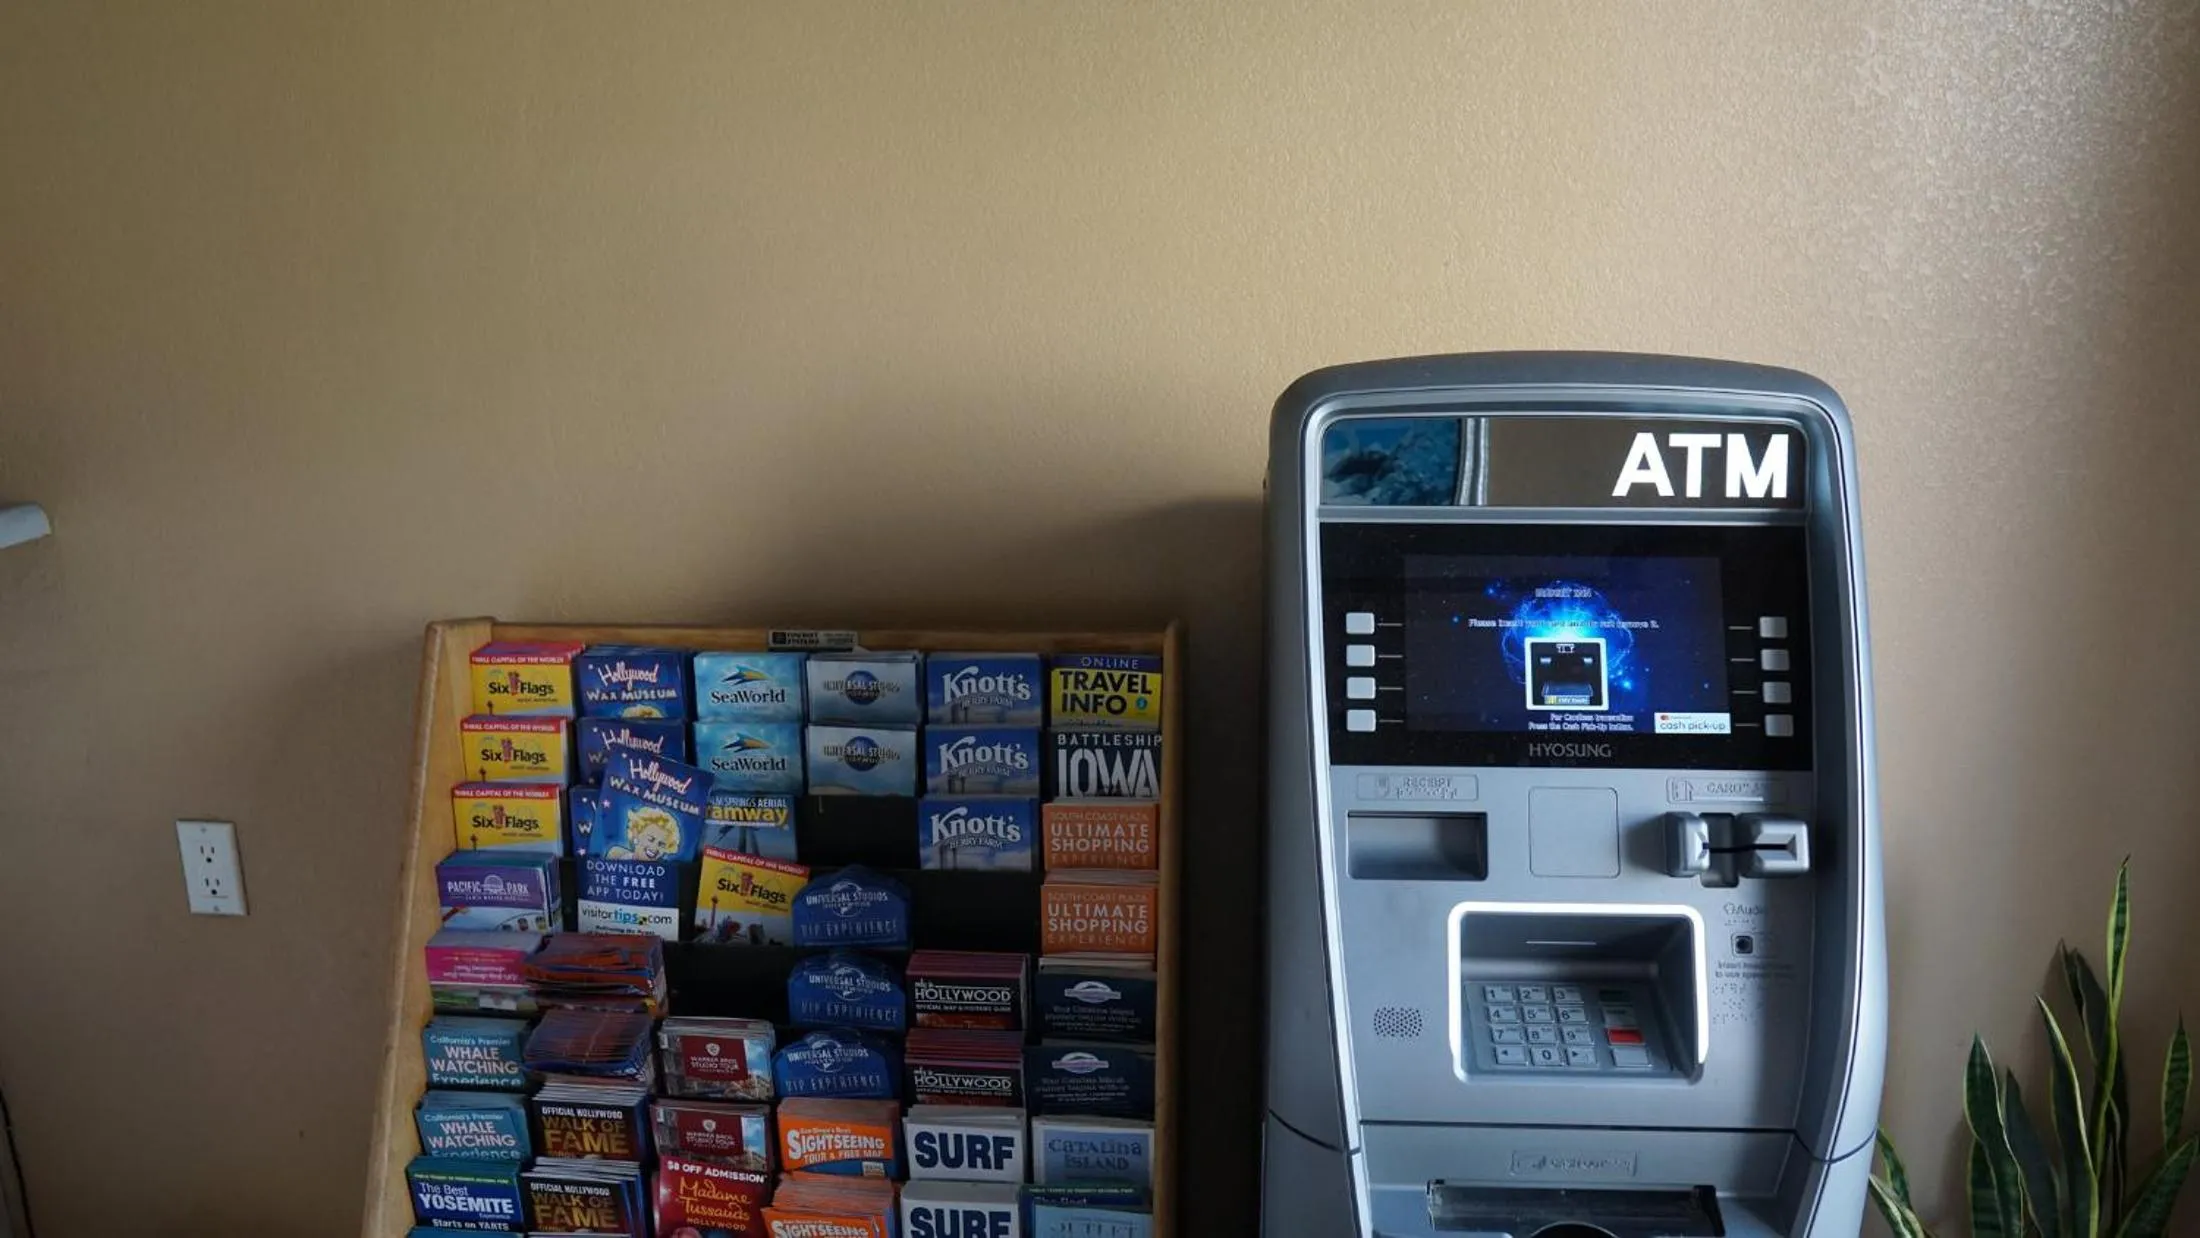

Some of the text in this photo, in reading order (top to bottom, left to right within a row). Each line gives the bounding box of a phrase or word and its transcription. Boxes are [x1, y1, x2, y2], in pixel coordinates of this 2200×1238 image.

[1612, 433, 1790, 499] ATM
[1080, 656, 1139, 670] ONLINE
[597, 661, 659, 690] Hollywood
[1060, 670, 1153, 695] TRAVEL
[488, 681, 555, 697] Six Flags
[942, 665, 1032, 703] Knott's
[621, 688, 678, 701] MUSEUM
[711, 688, 786, 704] SeaWorld
[1062, 694, 1128, 716] INFO
[1660, 720, 1727, 732] cash pick-up
[1057, 733, 1163, 748] BATTLESHIP
[481, 749, 547, 765] Six Flags
[938, 735, 1029, 774] Knott's
[1529, 744, 1613, 757] HYOSUNG
[711, 757, 786, 772] SeaWorld
[629, 753, 693, 794] Hollywood
[1058, 748, 1162, 798] IOWA
[642, 787, 700, 816] MUSEUM
[757, 798, 788, 808] AERIAL
[472, 816, 539, 831] Six Flags
[930, 805, 1022, 846] Knott's
[1051, 823, 1149, 838] ULTIMATE
[1051, 837, 1150, 854] SHOPPING
[586, 860, 666, 877] DOWNLOAD
[447, 881, 529, 895] PACIFIC PARK
[595, 874, 656, 889] THE FREE
[587, 885, 664, 902] APP TODAY!
[717, 878, 787, 904] Six Flags
[806, 891, 888, 906] UNIVERSAL STUDIOS
[1048, 903, 1148, 919] ULTIMATE
[825, 919, 898, 938] EXPERIENCE
[1048, 918, 1149, 934] SHOPPING
[809, 974, 891, 993] UNIVERSAL STUDIOS
[915, 987, 1012, 1002] HOLLYWOOD
[1490, 989, 1496, 999] 1
[1523, 991, 1531, 1000] 2
[1557, 991, 1566, 1000] 3
[826, 1002, 898, 1023] EXPERIENCE
[1492, 1010, 1501, 1019] 4
[1527, 1010, 1536, 1019] 5
[1561, 1010, 1570, 1020] 6
[477, 1037, 511, 1046] Premier
[1495, 1030, 1504, 1040] 7
[1531, 1031, 1540, 1040] 8
[1566, 1030, 1576, 1040] 9
[444, 1046, 500, 1060] WHALE
[786, 1050, 832, 1063] UNIVERSAL
[833, 1048, 869, 1058] STUDIOS
[1542, 1049, 1552, 1061] 0
[431, 1058, 519, 1074] WATCHING
[811, 1074, 882, 1092] EXPERIENCE
[914, 1076, 1011, 1089] HOLLYWOOD
[542, 1106, 623, 1119] OFFICIAL HOLLYWOOD
[440, 1121, 496, 1134] WHALE
[541, 1116, 626, 1133] WALK OF
[427, 1134, 517, 1149] WATCHING
[545, 1130, 630, 1154] FAME
[787, 1129, 885, 1160] SIGHTSEEING
[803, 1152, 827, 1163] TOUR
[914, 1131, 1015, 1170] SURF
[682, 1163, 702, 1174] OFF
[705, 1166, 765, 1184] ADMISSION
[420, 1182, 469, 1196] The Best
[530, 1182, 611, 1196] OFFICIAL HOLLYWOOD
[679, 1175, 751, 1205] Madame
[418, 1193, 515, 1214] YOSEMITE
[531, 1192, 617, 1208] WALK OF
[676, 1195, 751, 1221] Tussauds
[532, 1206, 619, 1228] FAME
[687, 1217, 746, 1231] HOLLYWOOD
[910, 1207, 1011, 1238] SURF
[432, 1219, 510, 1231] Starts on YARTS
